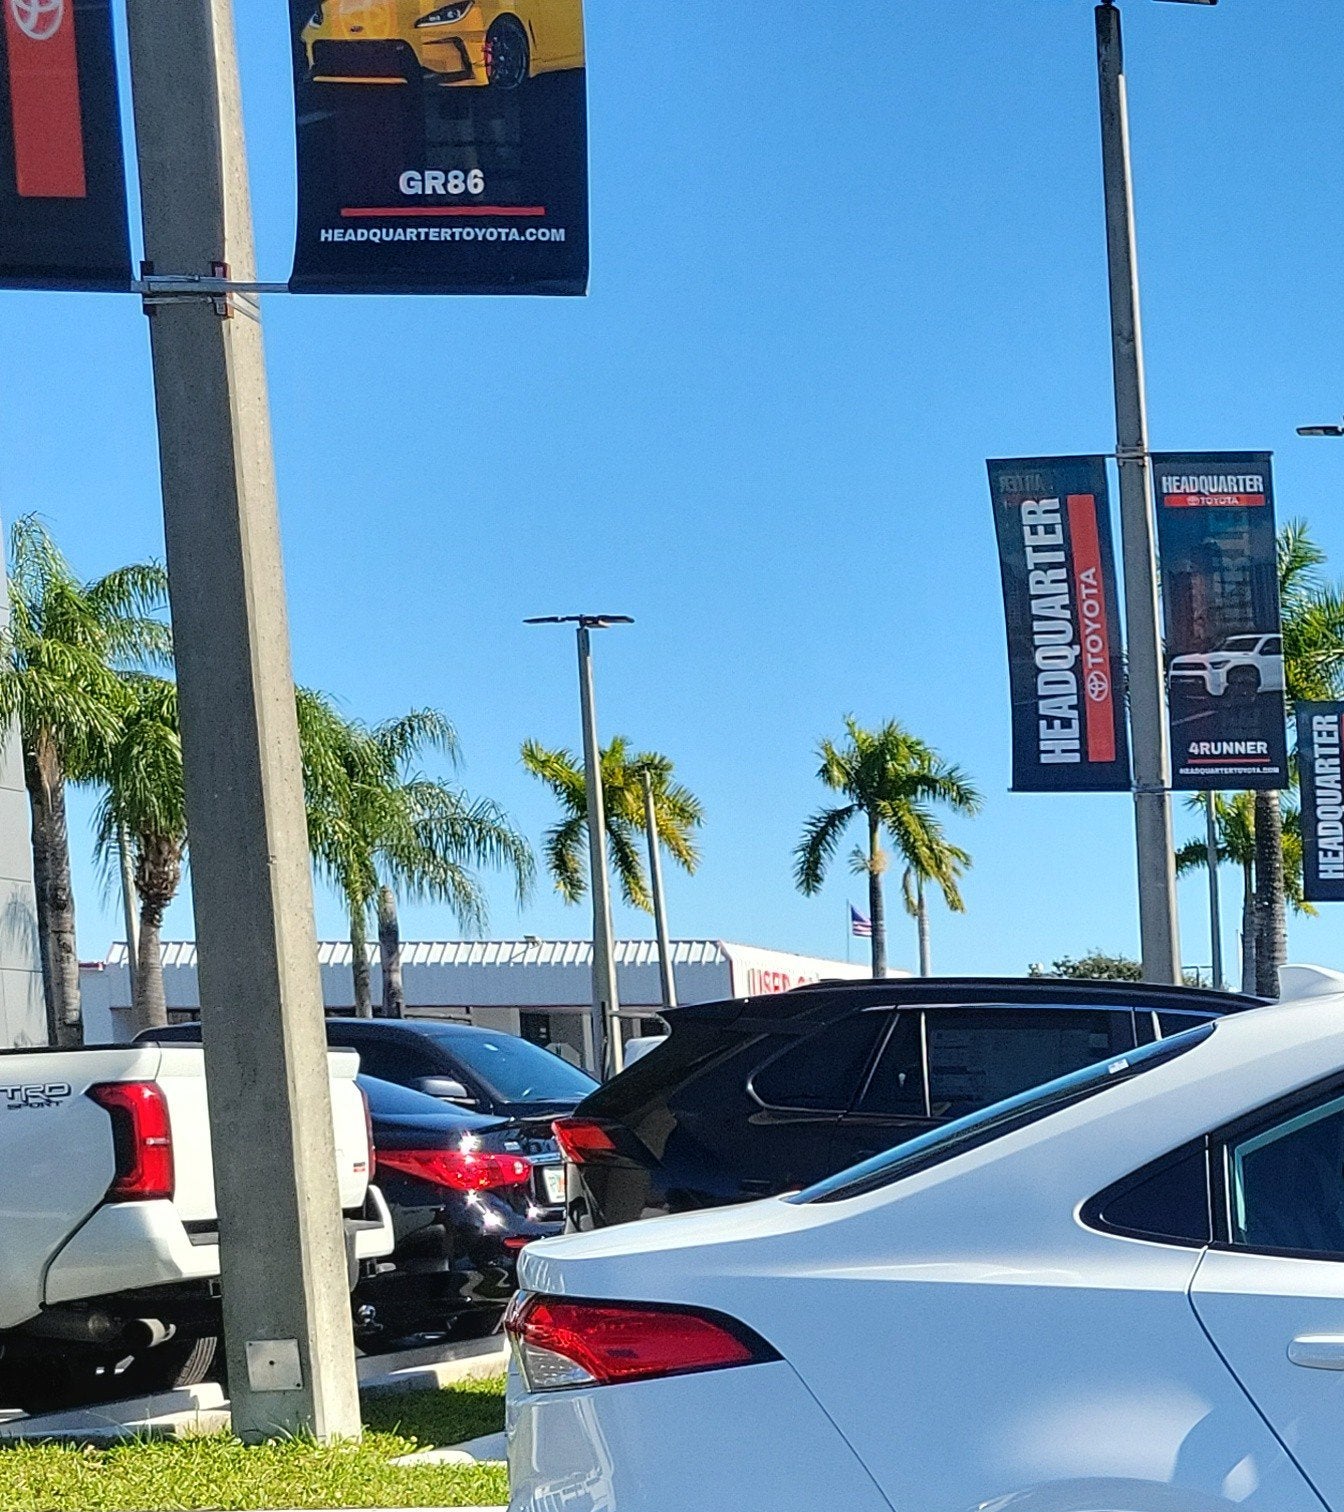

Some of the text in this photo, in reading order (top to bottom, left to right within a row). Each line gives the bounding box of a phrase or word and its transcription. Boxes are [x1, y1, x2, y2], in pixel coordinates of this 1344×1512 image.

[399, 169, 486, 195] GR86
[320, 227, 566, 242] HEADQUARTERTOYOTA.COM
[1162, 475, 1264, 495] HEADQUARTER
[1200, 496, 1239, 505] TOYOTA
[1080, 567, 1104, 668] TOYOTA
[1021, 497, 1081, 764] HEADQUARTER
[1188, 741, 1268, 755] 4RUNNER
[0, 1082, 71, 1104] TRD
